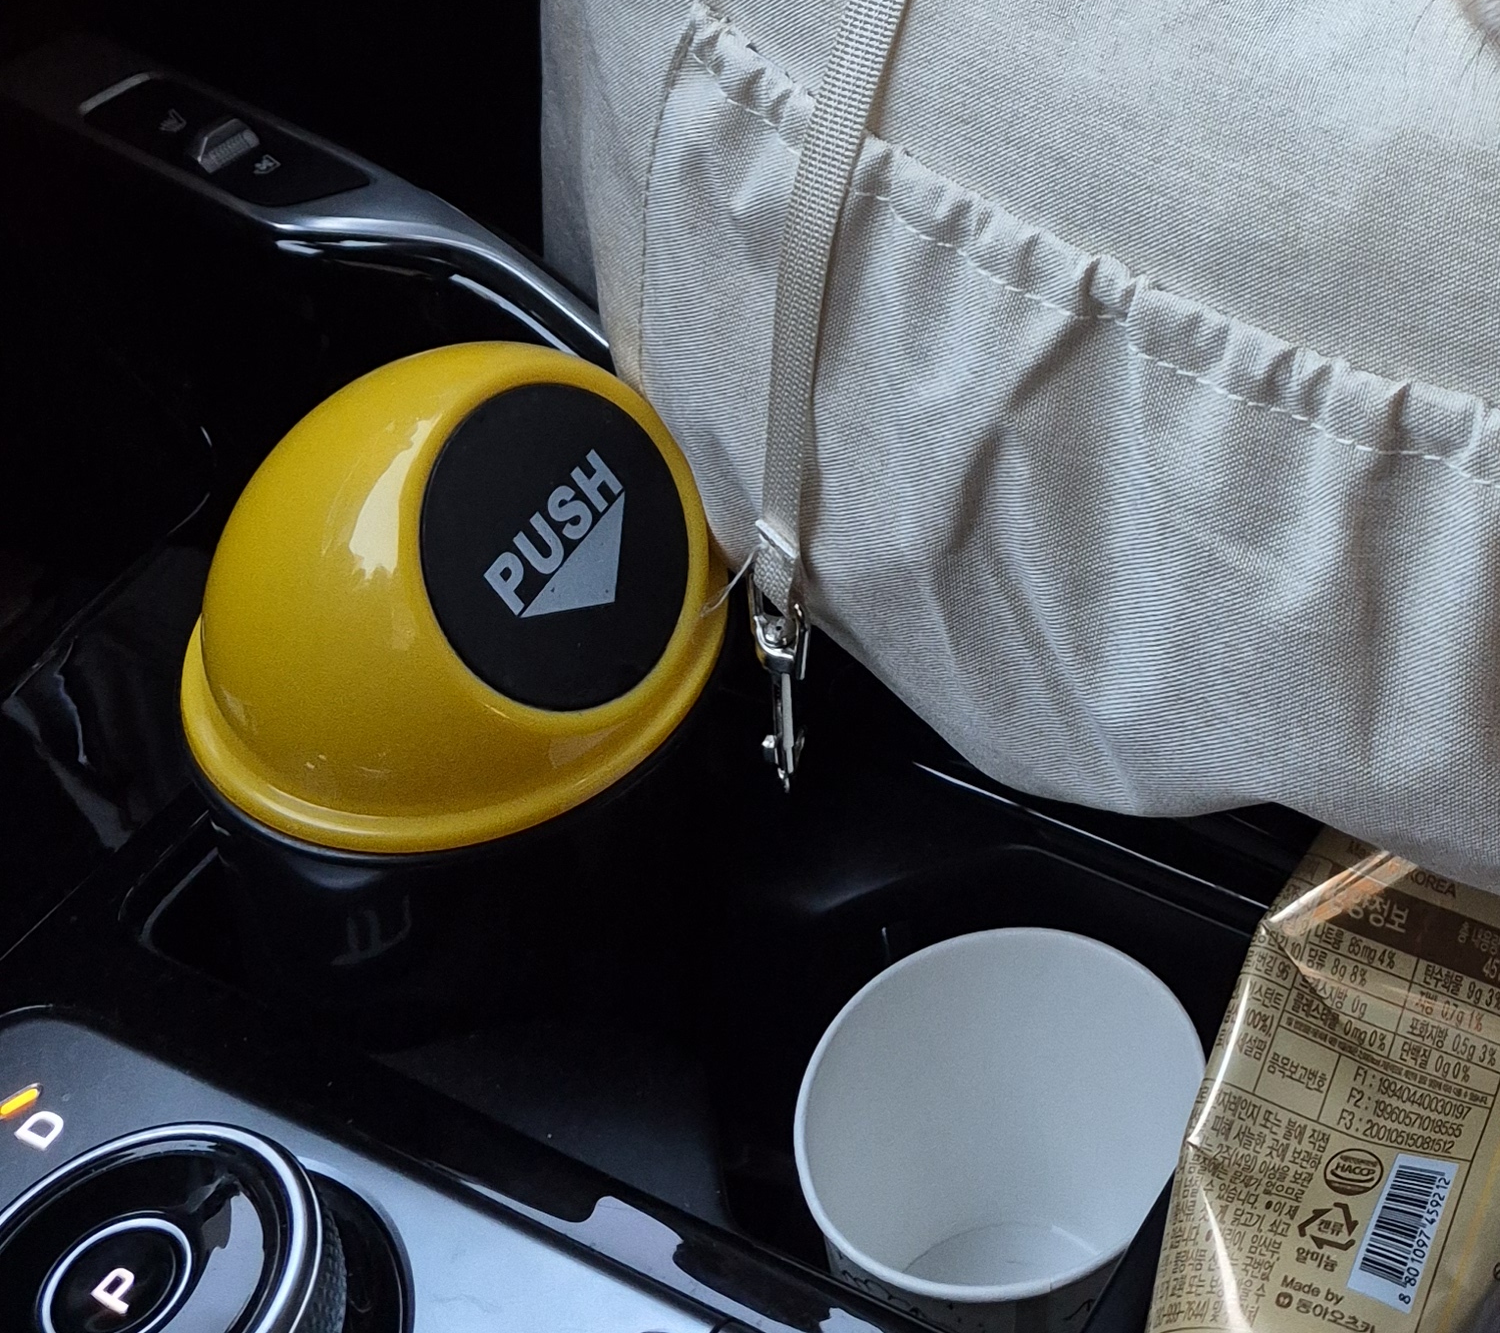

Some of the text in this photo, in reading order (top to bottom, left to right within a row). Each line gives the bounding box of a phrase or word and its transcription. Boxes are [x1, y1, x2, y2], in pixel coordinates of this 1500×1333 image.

[484, 449, 624, 617] PUSH
[1274, 960, 1292, 981] 96
[1304, 946, 1370, 987] 당류 8g 8%
[1376, 949, 1397, 969] 4%
[1421, 964, 1465, 996] 탄수화물
[1464, 980, 1485, 1005] 9g
[1348, 994, 1369, 1020] 0g
[1340, 1019, 1369, 1046] 0mg
[1366, 1028, 1389, 1052] 0%
[1405, 1015, 1500, 1067] 포화지방 0.5g 3%
[1265, 1045, 1332, 1093] 품목보고번호
[1352, 1065, 1369, 1085] F1
[1397, 1039, 1473, 1083] 단백질 0g 0%
[1345, 1086, 1366, 1108] F2
[14, 1111, 64, 1151] D
[1258, 1108, 1285, 1136] 또는
[1281, 1117, 1307, 1145] 불에
[1305, 1127, 1331, 1153] 직접
[1336, 1108, 1355, 1130] F3
[1209, 1113, 1234, 1141] 피해
[1231, 1124, 1268, 1154] 서늘한
[1264, 1136, 1290, 1162] 곳에
[1288, 1145, 1323, 1172] 보관하
[1228, 1167, 1263, 1192] 문제가
[1262, 1178, 1305, 1205] 없으므로
[1256, 1158, 1291, 1184] 이상을
[1289, 1168, 1314, 1189] 보관
[1335, 1161, 1377, 1179] HACCP
[1215, 1181, 1261, 1212] 있습니다.
[1230, 1205, 1266, 1234] 닭고기,
[1266, 1216, 1292, 1240] 쇠고
[1217, 1223, 1248, 1252] 린이,
[1247, 1232, 1285, 1261] 임신부,
[1293, 1245, 1339, 1273] 알미늄
[90, 1267, 135, 1315] P
[1280, 1274, 1345, 1306] Made by
